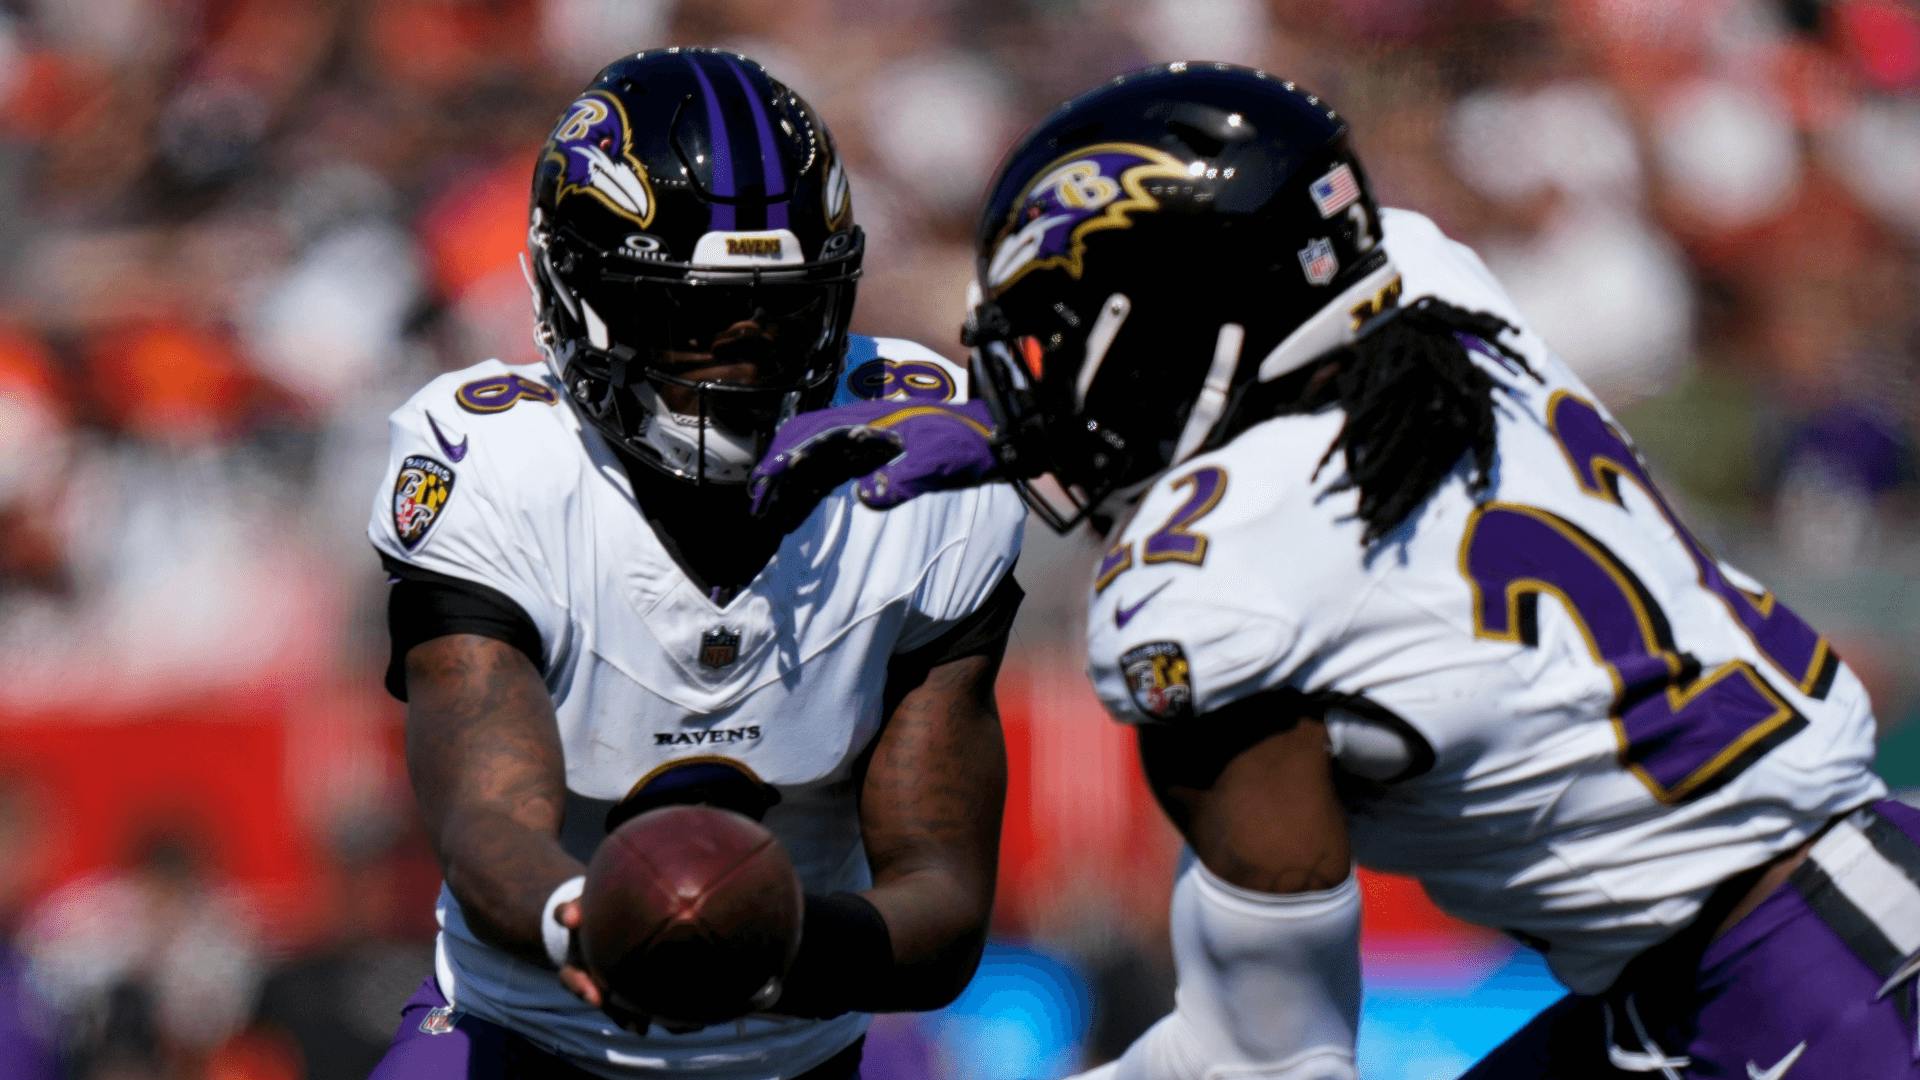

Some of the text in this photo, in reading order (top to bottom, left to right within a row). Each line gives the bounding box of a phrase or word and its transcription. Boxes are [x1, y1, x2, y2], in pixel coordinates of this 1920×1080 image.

[726, 236, 782, 255] RAVENS
[847, 356, 957, 400] 8
[1458, 388, 1840, 806] 22
[653, 725, 761, 746] RAVENS
